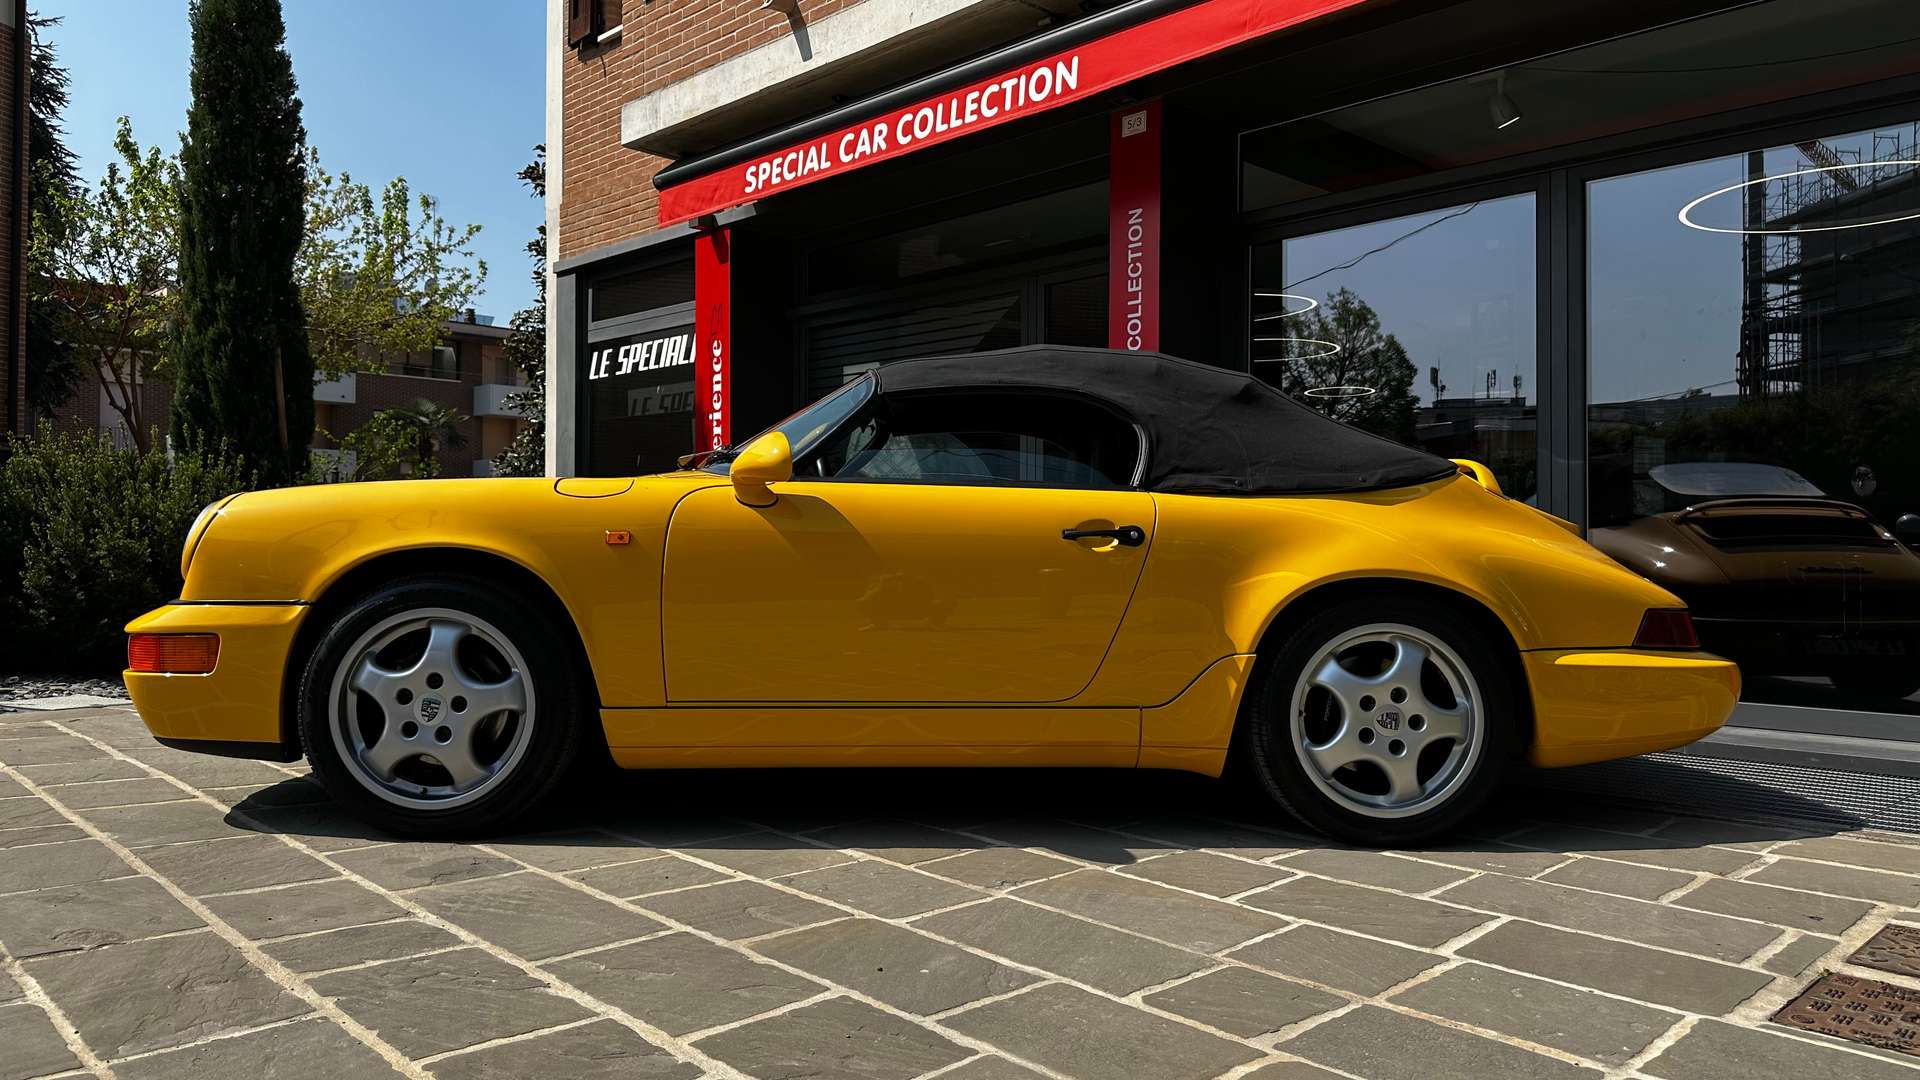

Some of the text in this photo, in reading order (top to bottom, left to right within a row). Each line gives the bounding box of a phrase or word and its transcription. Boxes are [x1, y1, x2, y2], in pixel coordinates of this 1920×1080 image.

[744, 55, 1079, 194] SPECIAL CAR COLLECTION
[1127, 116, 1142, 130] 5/3
[1127, 208, 1143, 351] COLLECTION
[588, 348, 613, 380] LE
